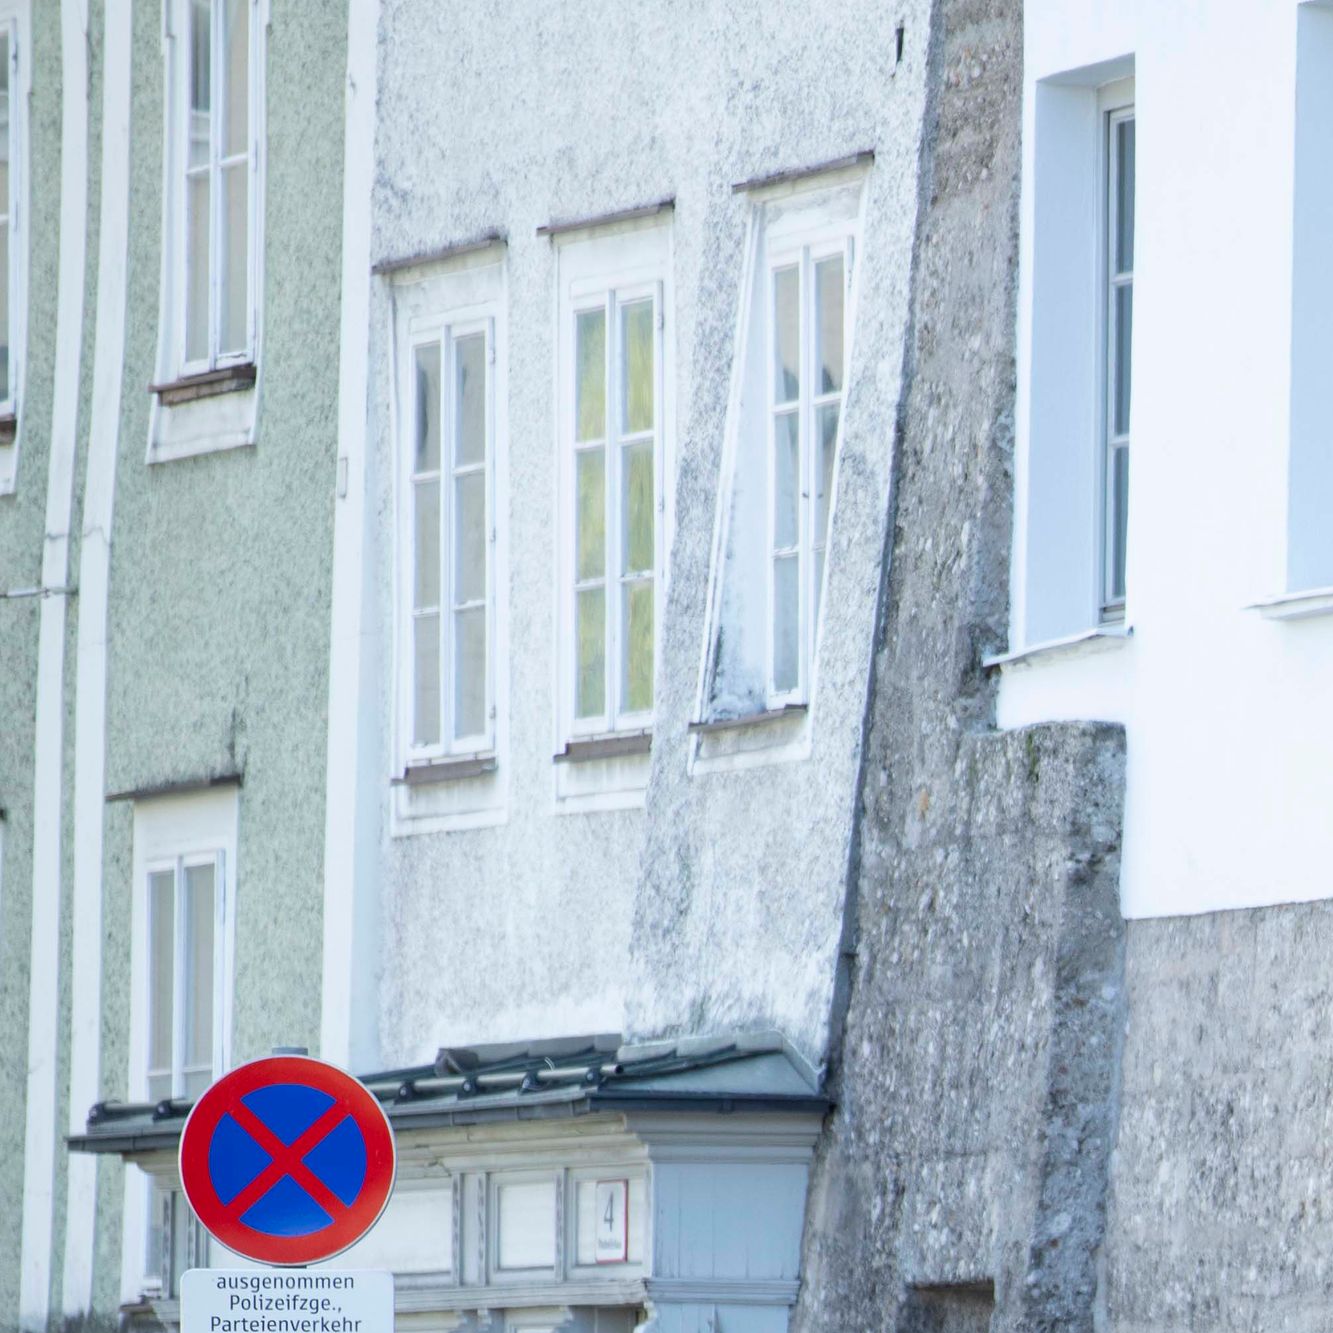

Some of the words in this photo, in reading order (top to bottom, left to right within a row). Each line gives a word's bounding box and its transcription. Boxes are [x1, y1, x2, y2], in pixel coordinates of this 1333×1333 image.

[603, 1190, 615, 1233] 4
[216, 1276, 355, 1293] ausgenommen
[230, 1294, 342, 1314] Polizeifzge.,
[210, 1316, 362, 1333] Parteienverkehr
